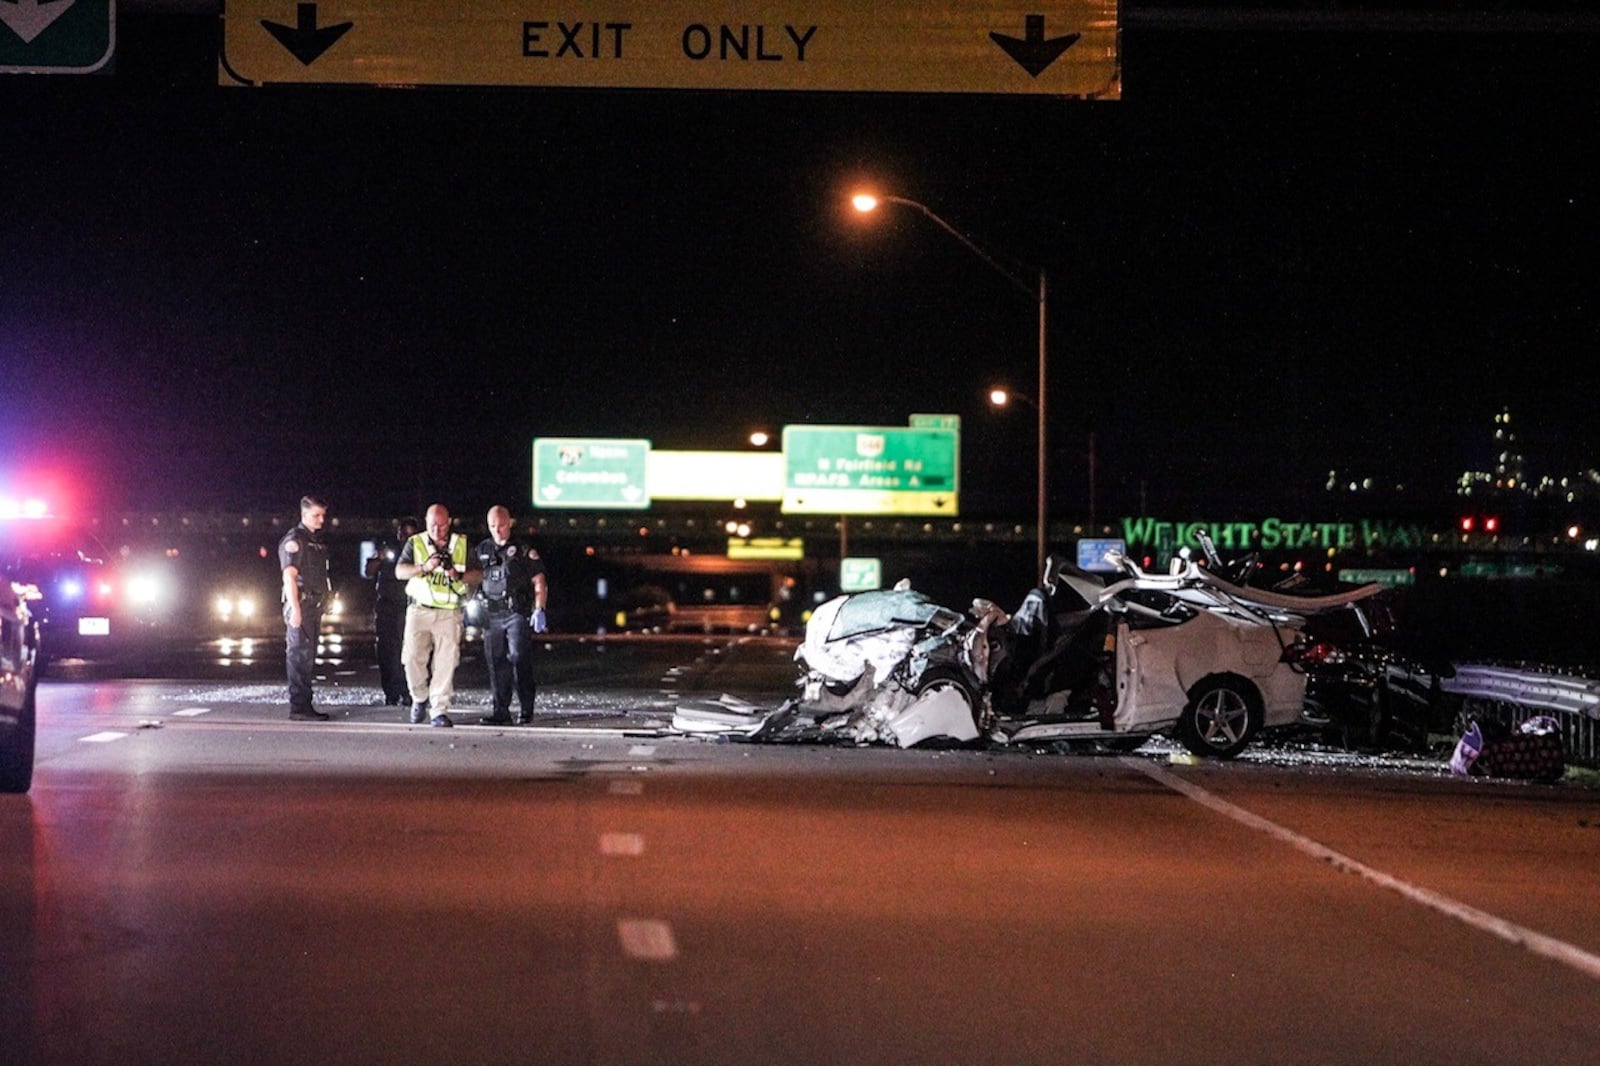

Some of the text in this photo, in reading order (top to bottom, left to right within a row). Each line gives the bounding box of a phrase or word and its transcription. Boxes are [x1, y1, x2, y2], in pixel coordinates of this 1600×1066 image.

[522, 21, 818, 61] EXIT ONLY
[836, 457, 896, 471] Fairfield
[904, 459, 922, 472] Rd
[1261, 517, 1353, 549] STATE
